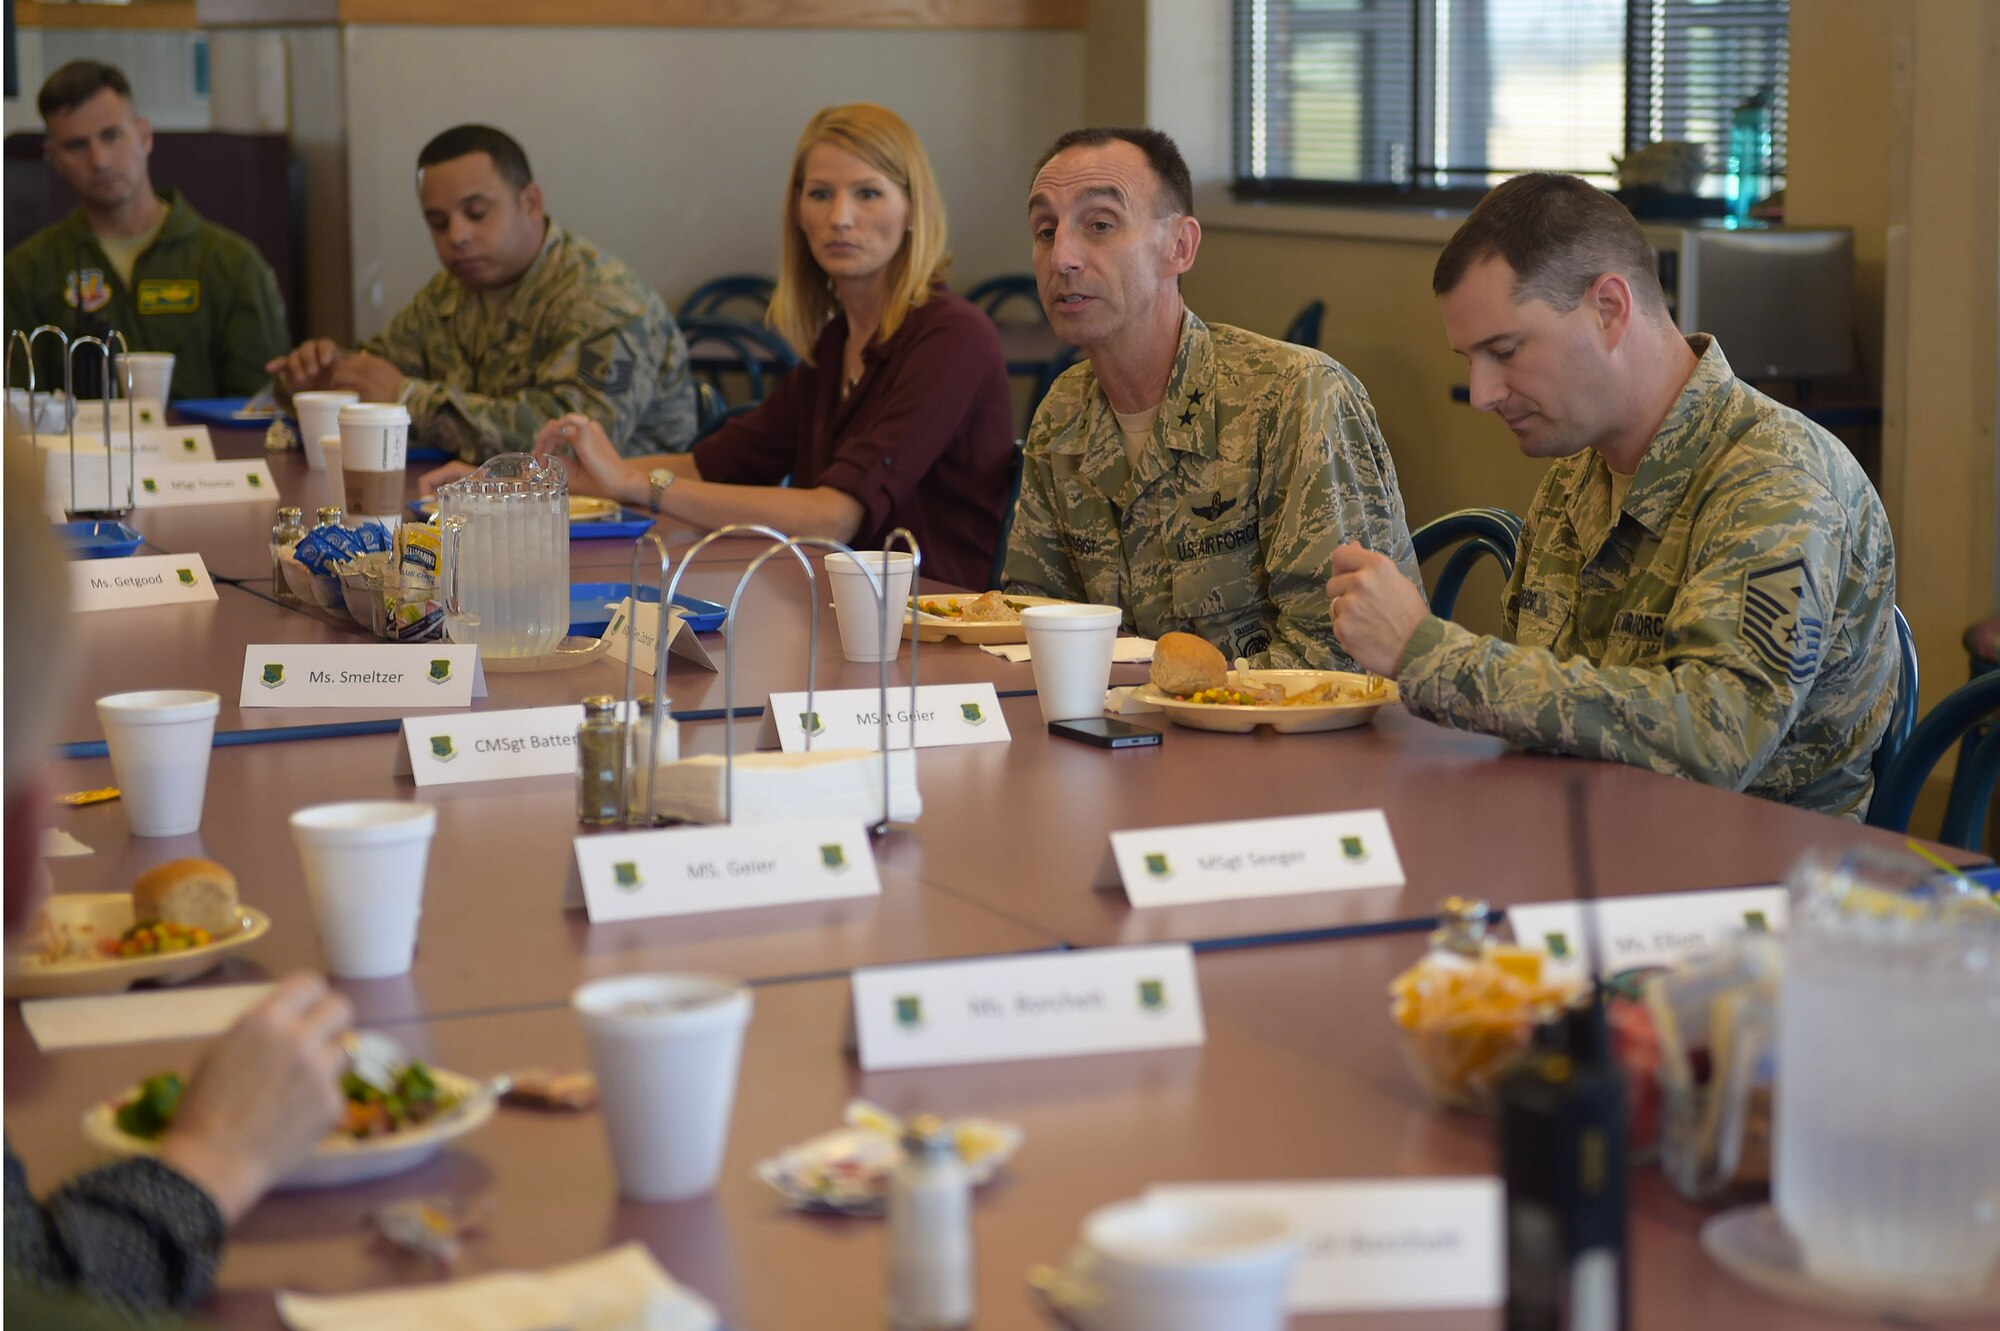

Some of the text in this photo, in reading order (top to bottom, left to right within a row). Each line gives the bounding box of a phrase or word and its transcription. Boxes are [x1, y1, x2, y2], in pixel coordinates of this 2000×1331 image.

[1198, 535, 1216, 554] AIR
[90, 574, 163, 589] Ms. Getgood
[309, 670, 404, 683] Ms. Smeltzer
[474, 735, 526, 753] CMSgt
[727, 858, 776, 877] Geier
